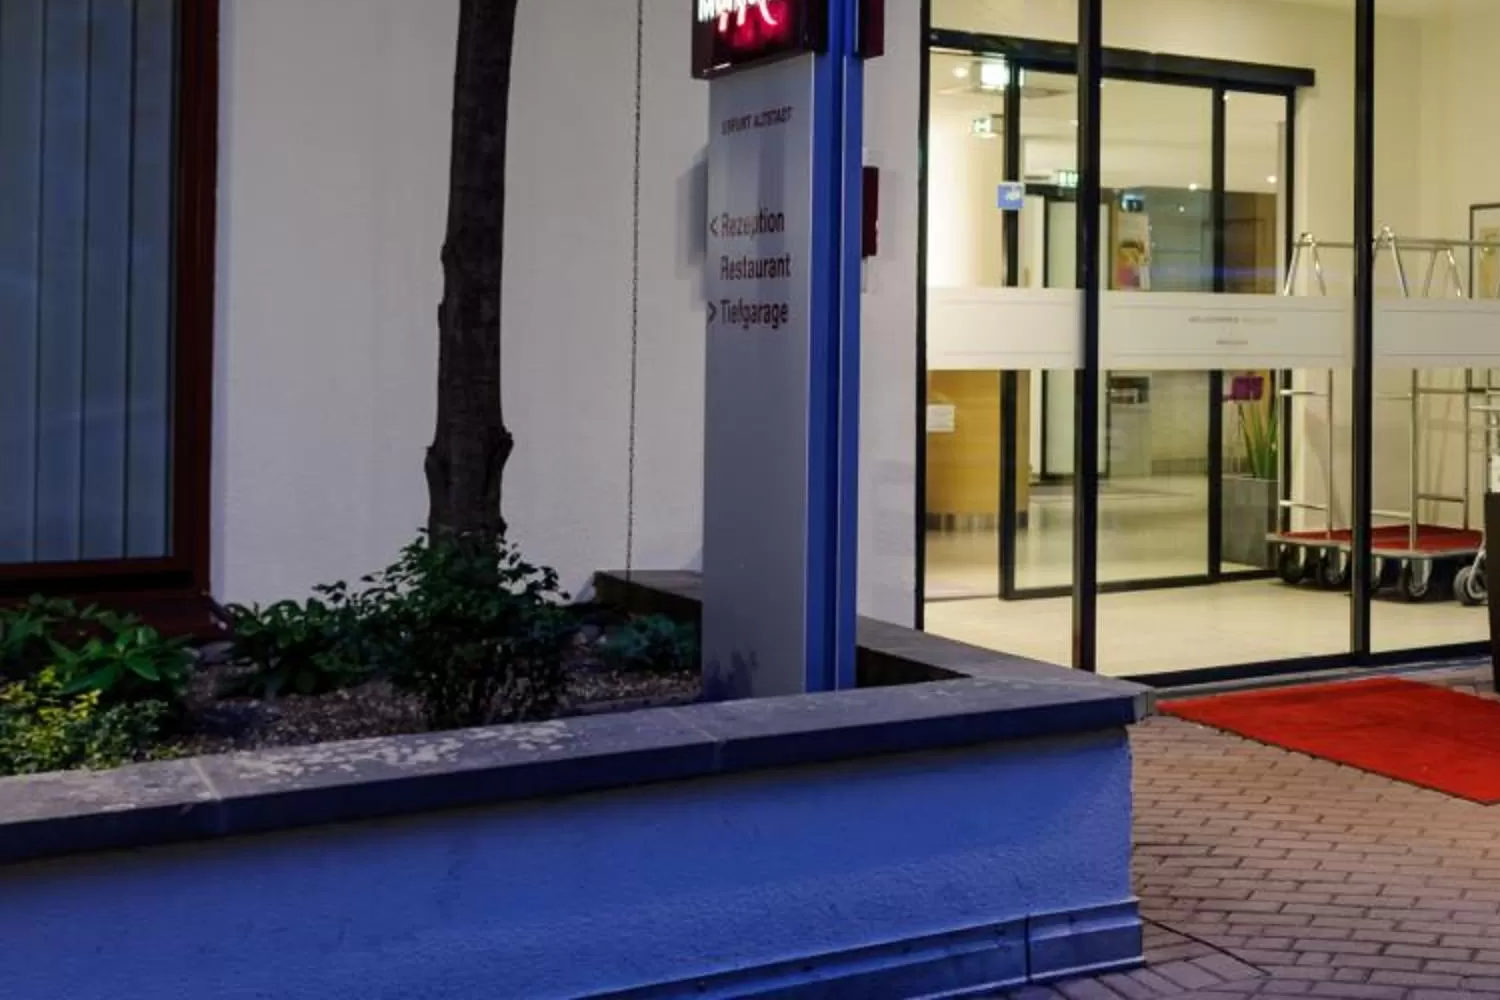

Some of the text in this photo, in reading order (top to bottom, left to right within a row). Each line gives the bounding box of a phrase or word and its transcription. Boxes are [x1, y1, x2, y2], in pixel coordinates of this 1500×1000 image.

[720, 208, 785, 238] Rezeption
[720, 252, 791, 281] Restaurant
[719, 297, 789, 330] Tiefgarage
